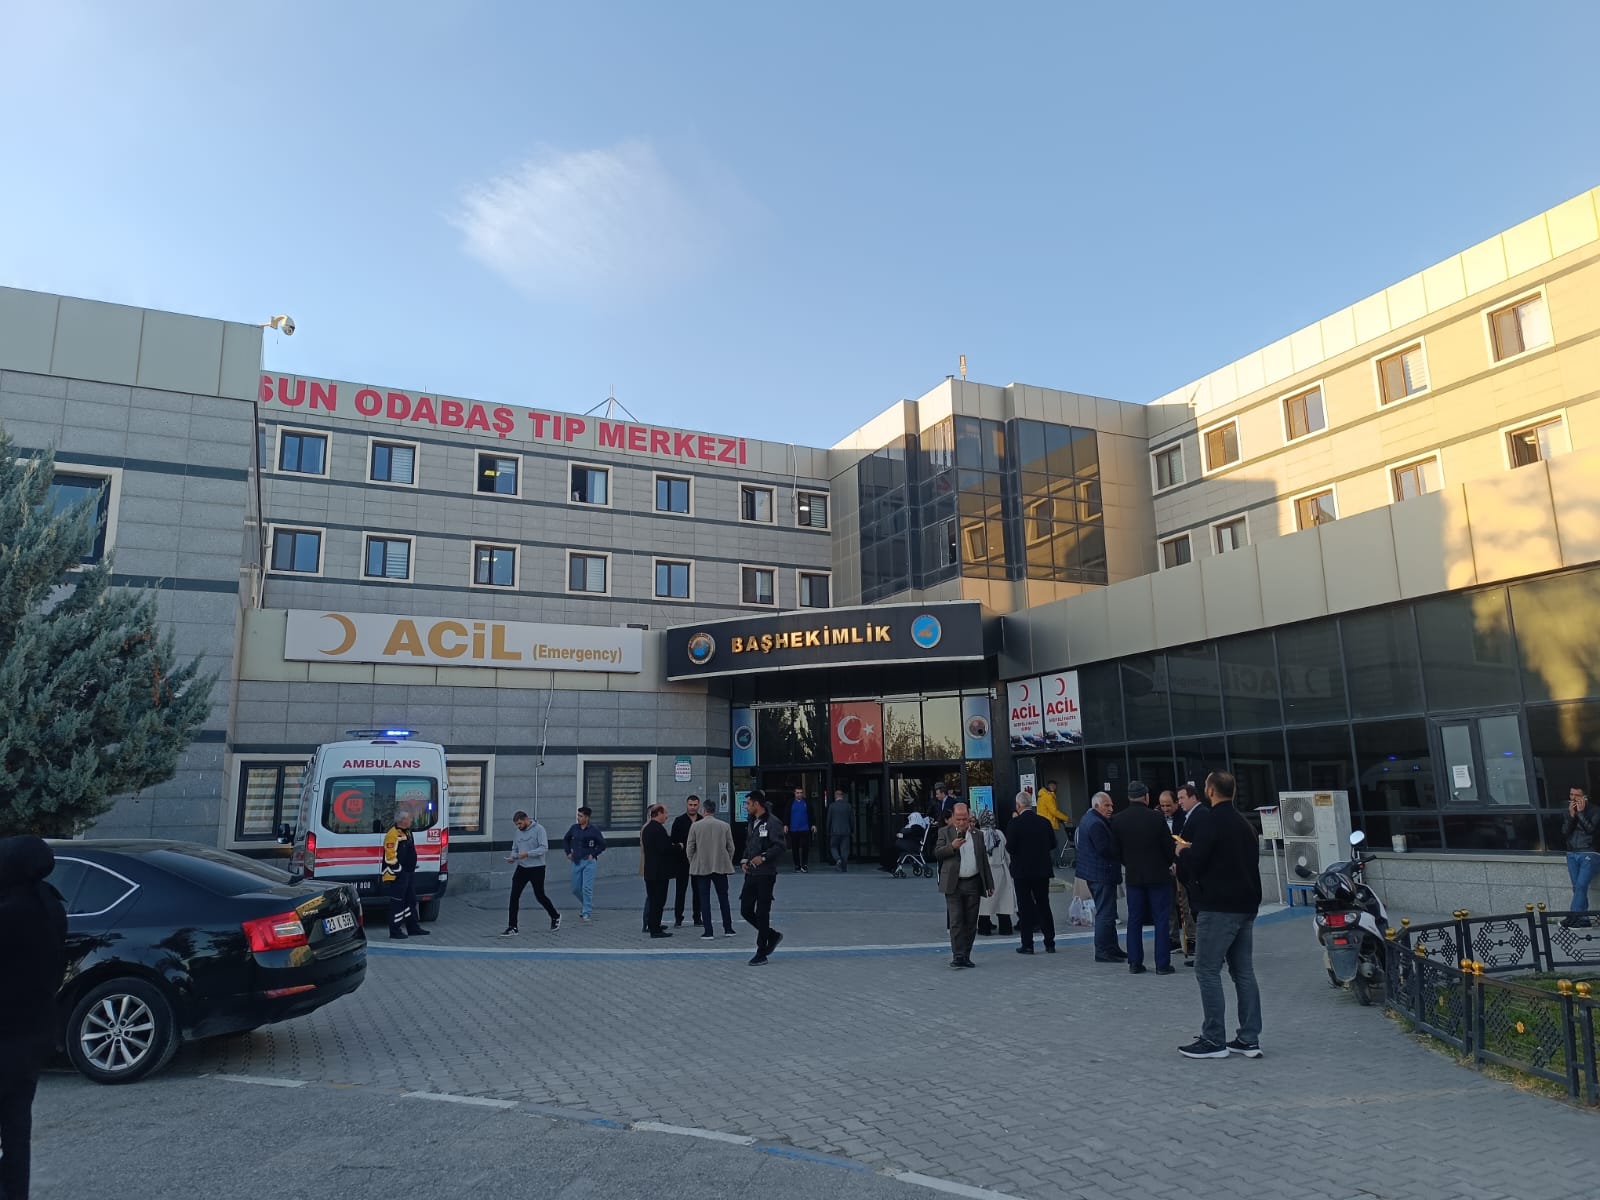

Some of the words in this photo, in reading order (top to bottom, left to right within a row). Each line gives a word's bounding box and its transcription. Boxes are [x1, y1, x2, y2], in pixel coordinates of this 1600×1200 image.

[354, 389, 515, 440] ODABAŞ
[528, 411, 586, 442] TIP
[599, 421, 747, 465] MERKEZİ
[731, 622, 892, 654] BAŞHEKİMLİK
[532, 643, 623, 664] (Emergency)
[1011, 703, 1040, 720] ACİL
[1046, 697, 1078, 715] ACİL
[342, 759, 421, 769] AMBULANS
